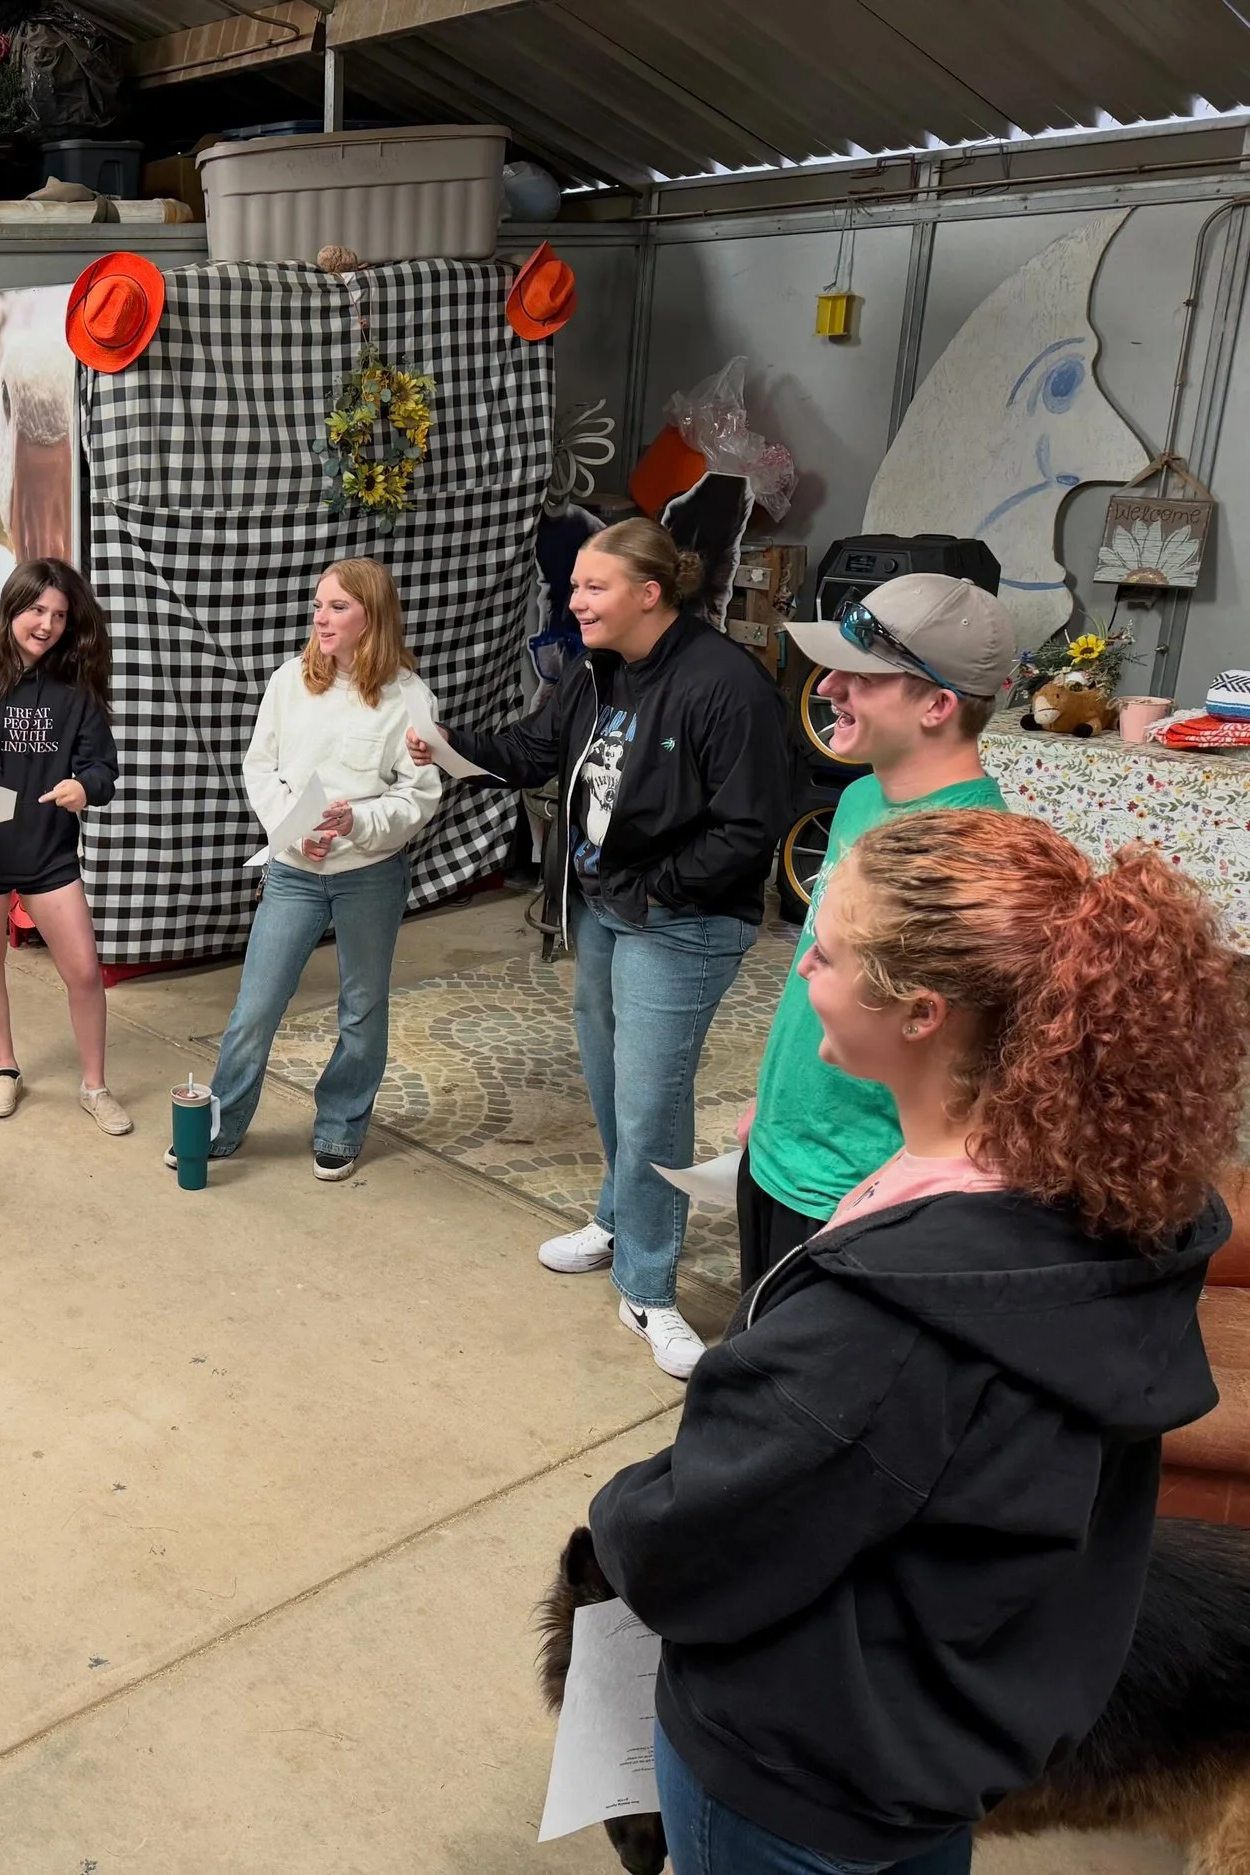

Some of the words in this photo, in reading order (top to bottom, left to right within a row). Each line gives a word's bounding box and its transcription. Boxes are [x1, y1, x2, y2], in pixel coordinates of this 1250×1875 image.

[1114, 503, 1202, 524] Welcome
[6, 706, 51, 719] TREAT
[3, 717, 54, 730] PEOPLE
[8, 729, 47, 741] WITH
